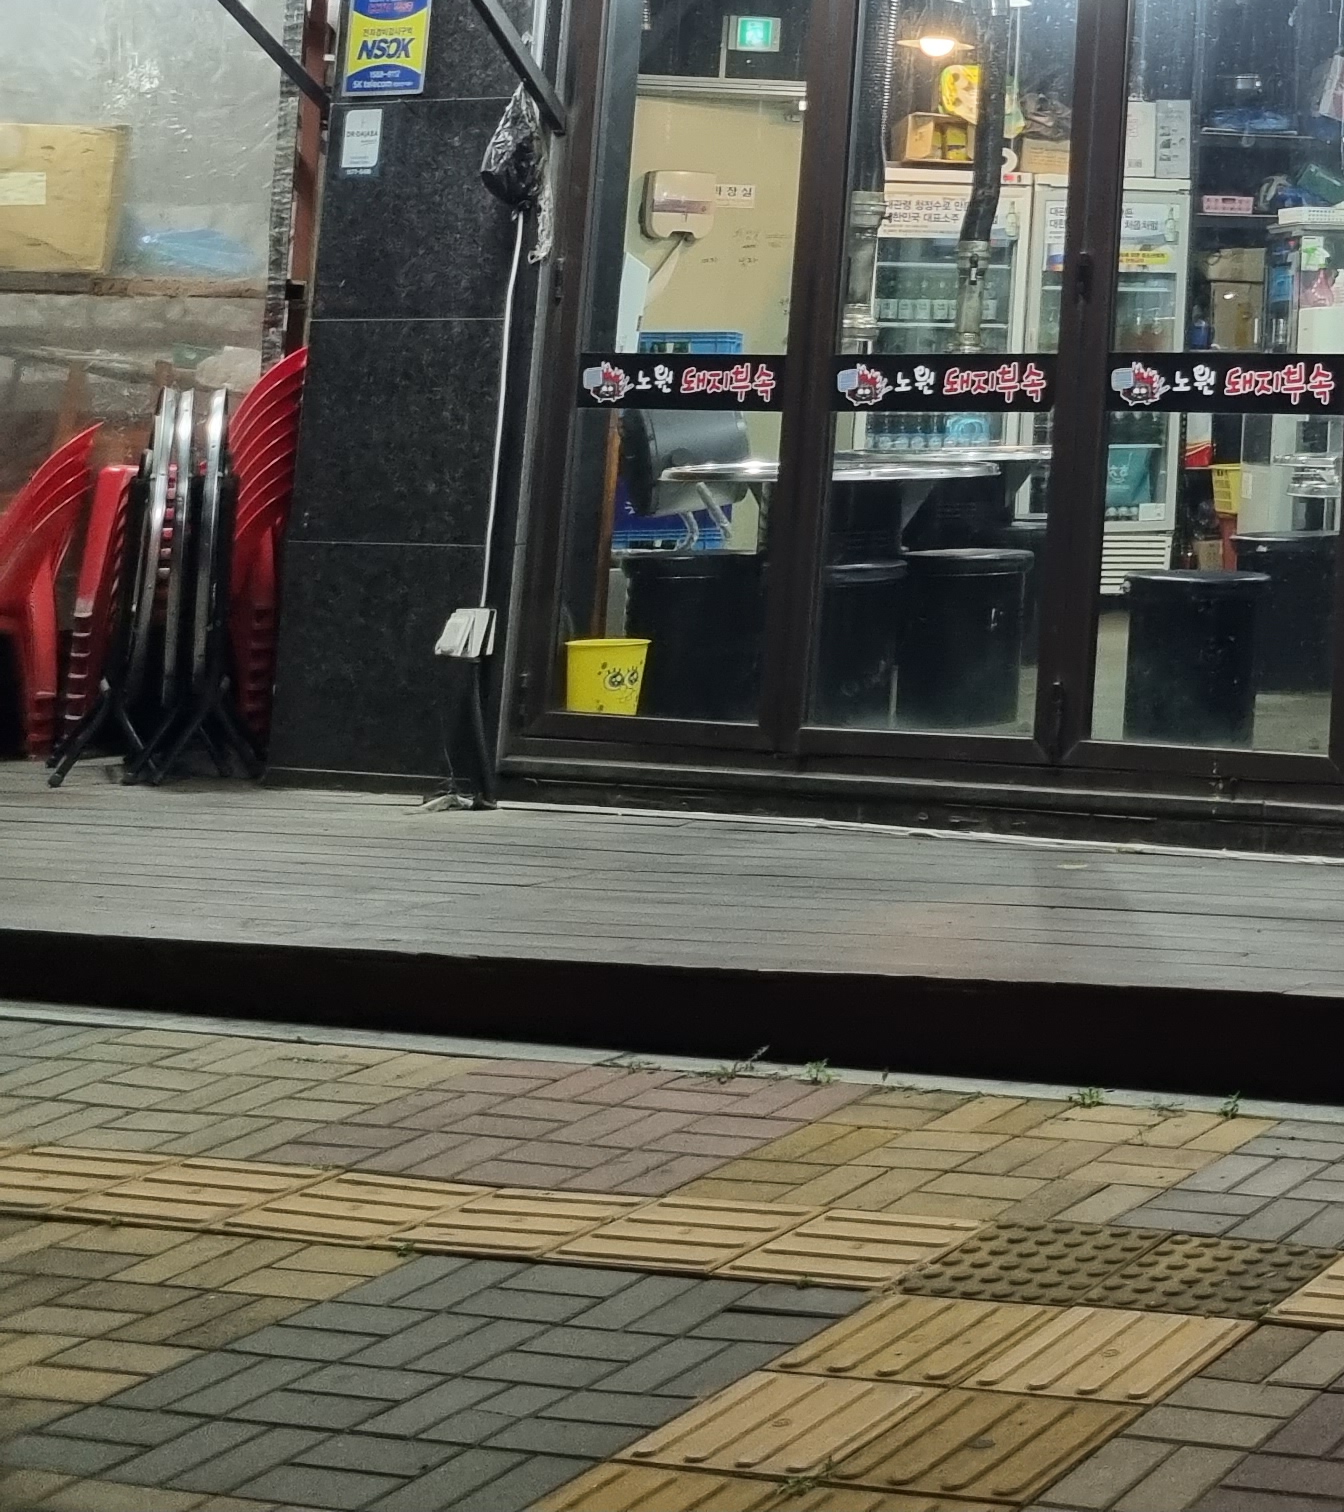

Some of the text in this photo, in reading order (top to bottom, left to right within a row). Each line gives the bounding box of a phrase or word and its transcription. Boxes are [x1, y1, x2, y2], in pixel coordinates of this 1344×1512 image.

[357, 37, 415, 61] NSOK
[680, 361, 777, 403] 돼지부속
[942, 361, 1047, 405] 돼지부속
[1223, 361, 1335, 406] 돼지부속
